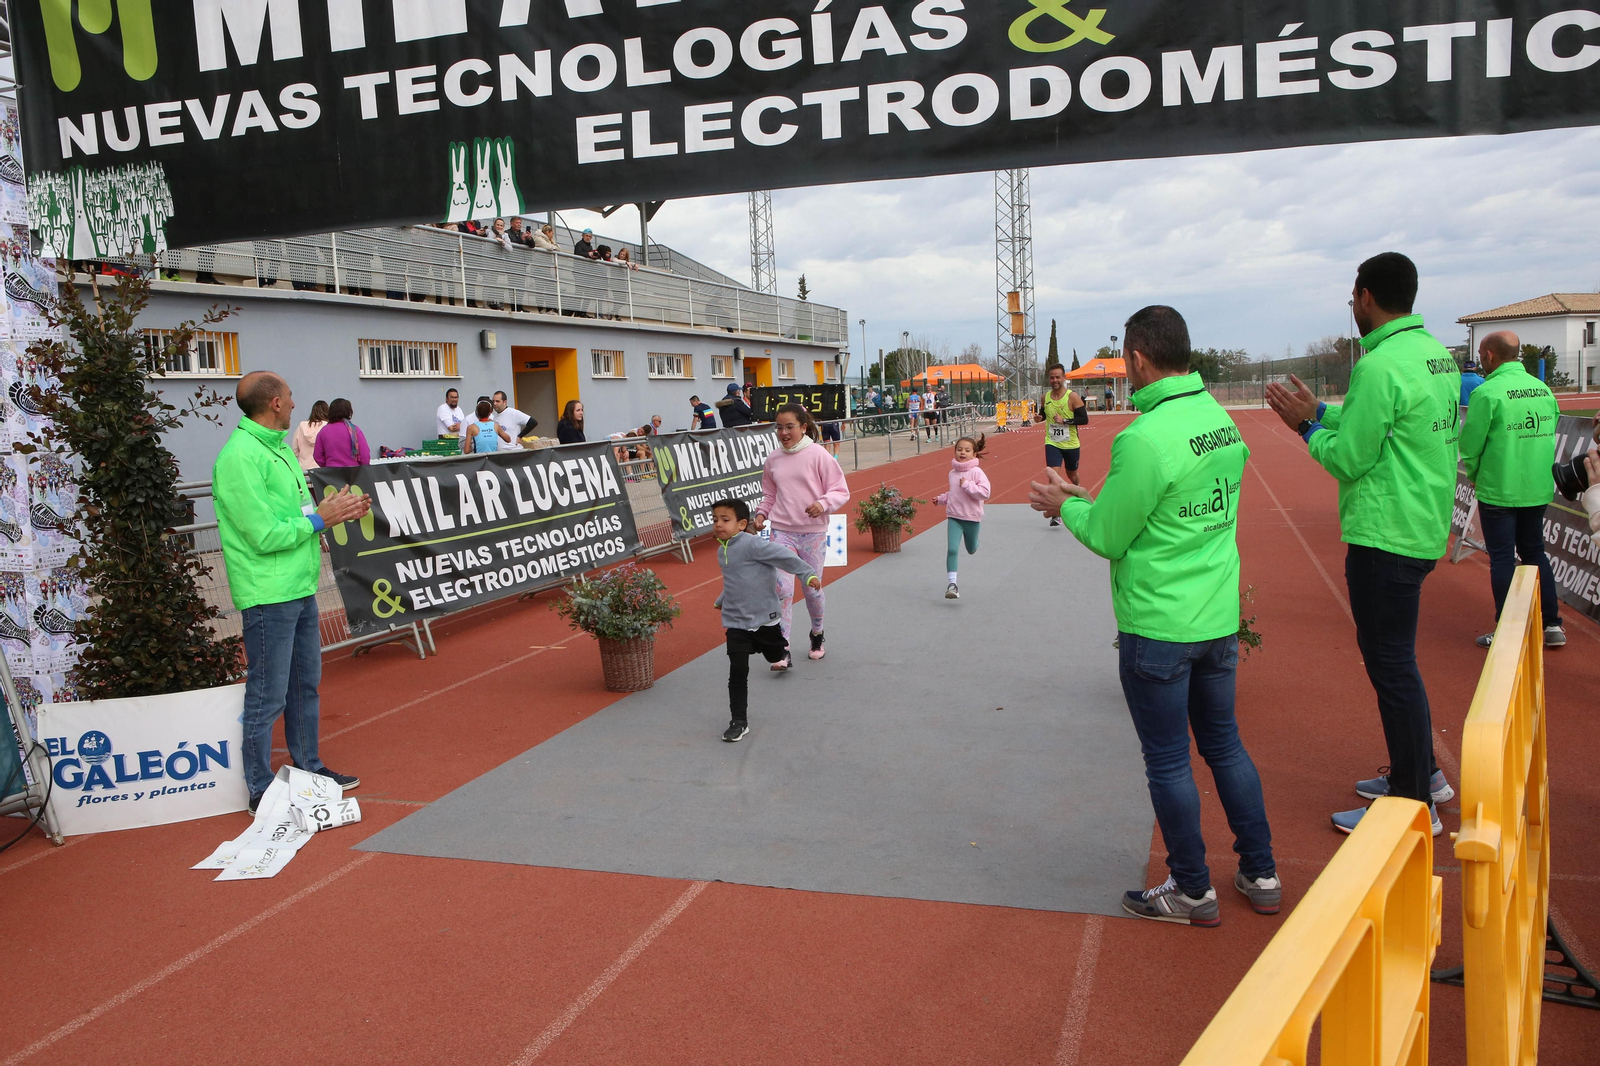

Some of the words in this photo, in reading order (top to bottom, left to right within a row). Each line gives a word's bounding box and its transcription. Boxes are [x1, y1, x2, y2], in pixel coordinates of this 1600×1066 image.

[58, 83, 322, 159] NUEVAS
[344, 0, 968, 121] TECNOLOGÍAS
[1007, 0, 1116, 53] &
[1053, 428, 1064, 436] 731
[673, 438, 733, 482] MILAR
[374, 470, 508, 538] MILAR
[506, 455, 621, 515] LUCENA
[679, 506, 695, 531] &
[686, 488, 728, 511] NUEVAS
[395, 545, 493, 584] NUEVAS
[496, 514, 623, 560] TECNOLOGÍAS
[371, 578, 406, 619] &
[408, 536, 627, 611] ELECTRODOMESTICOS
[44, 737, 75, 757] EL
[52, 739, 231, 791] GALEÓN
[76, 793, 129, 808] flores
[133, 791, 145, 801] y
[149, 778, 216, 800] plantas
